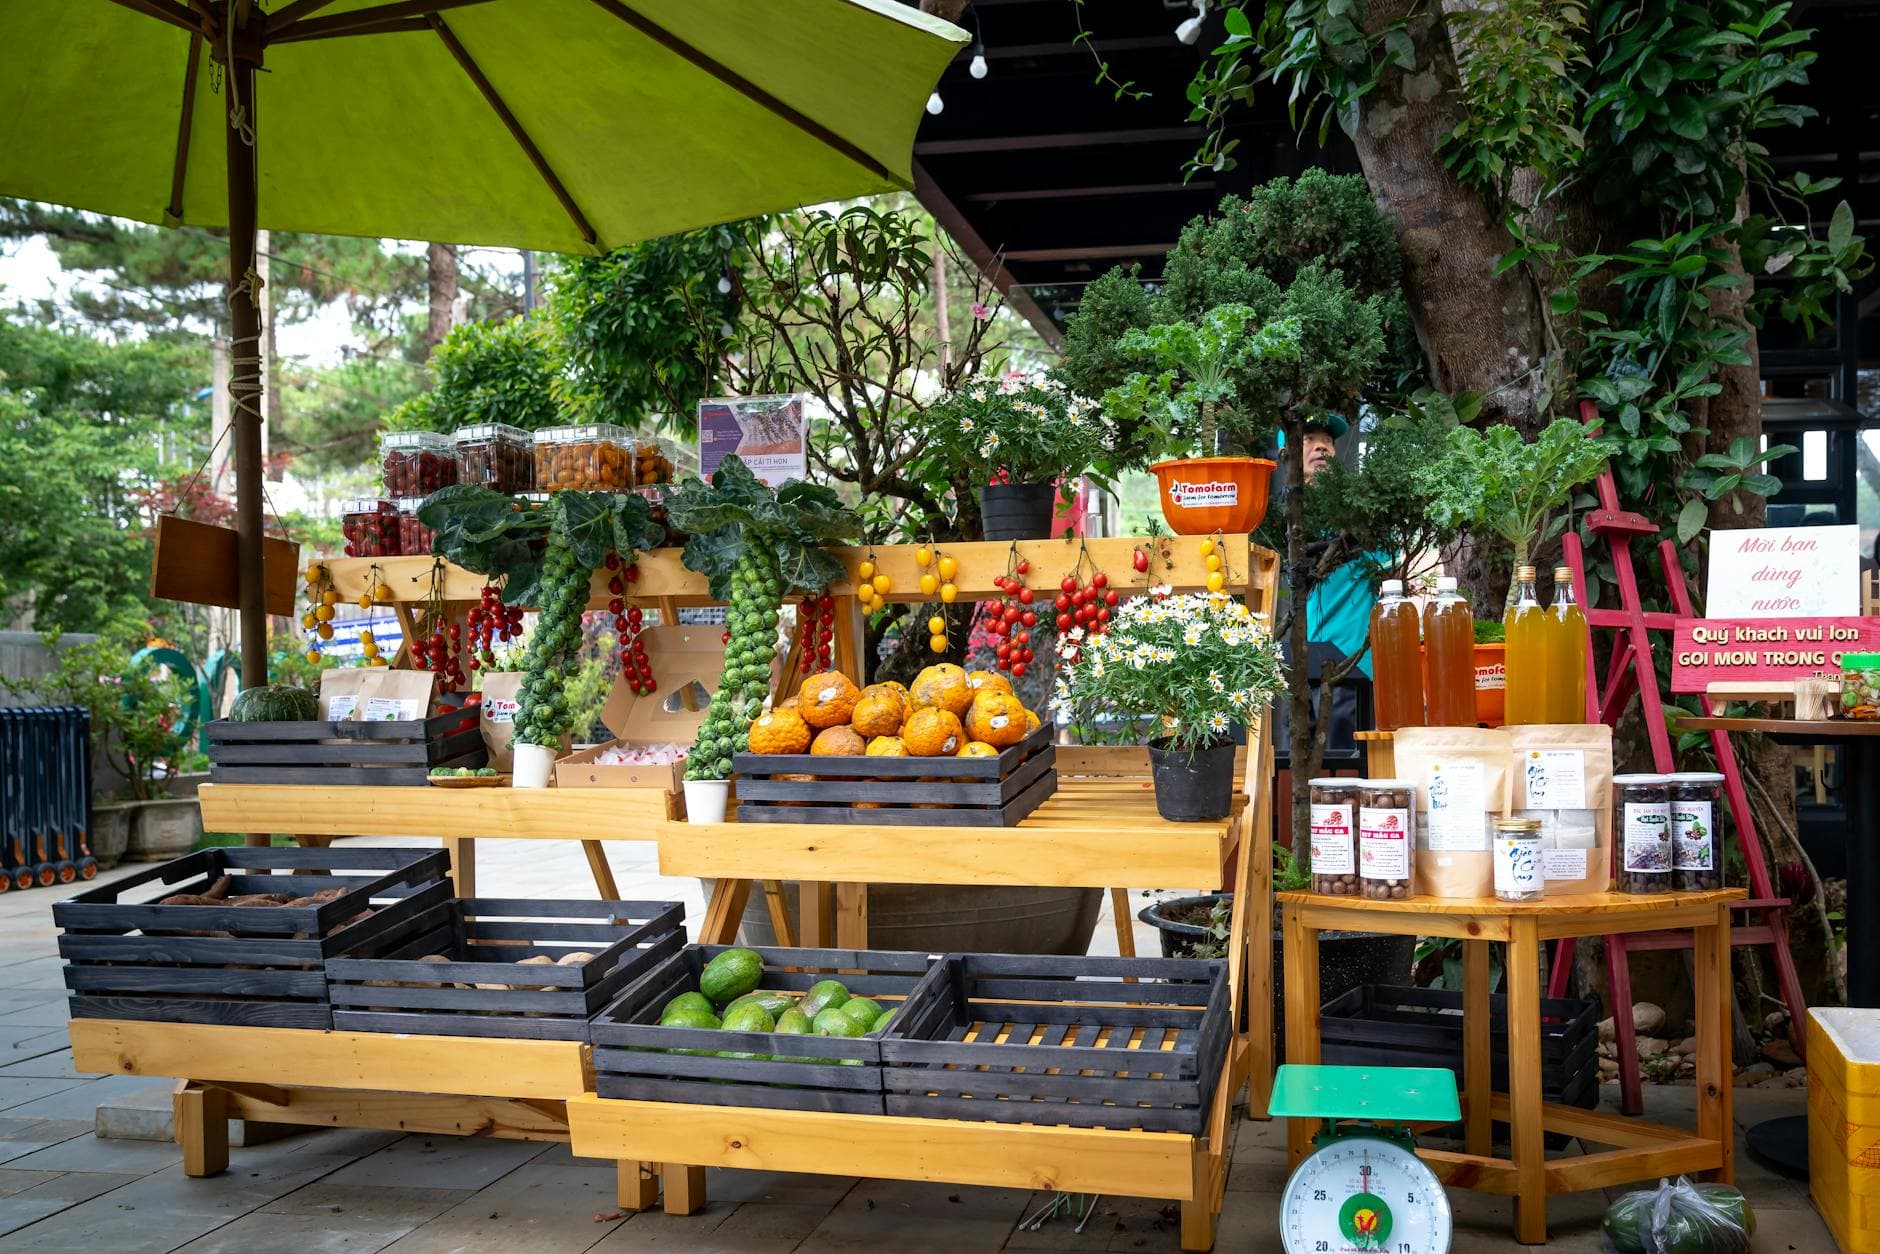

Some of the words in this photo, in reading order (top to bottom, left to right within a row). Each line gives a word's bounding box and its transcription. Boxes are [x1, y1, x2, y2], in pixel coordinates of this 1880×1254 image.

[1182, 484, 1236, 493] Tomofarm
[1738, 537, 1776, 553] Mời
[1780, 535, 1818, 555] bạn
[1752, 565, 1802, 589] dùng
[1751, 596, 1801, 611] nước
[1692, 626, 1729, 645] Quý
[1735, 626, 1788, 641] khach
[1795, 625, 1823, 641] vui
[1829, 624, 1859, 640] lon
[1714, 651, 1758, 666] MON
[1763, 650, 1825, 666] TRONG
[1359, 1165, 1372, 1176] 30
[1314, 1189, 1327, 1201] 25
[1407, 1192, 1414, 1203] 5
[1316, 1241, 1328, 1252] 20
[1398, 1243, 1410, 1254] 10
